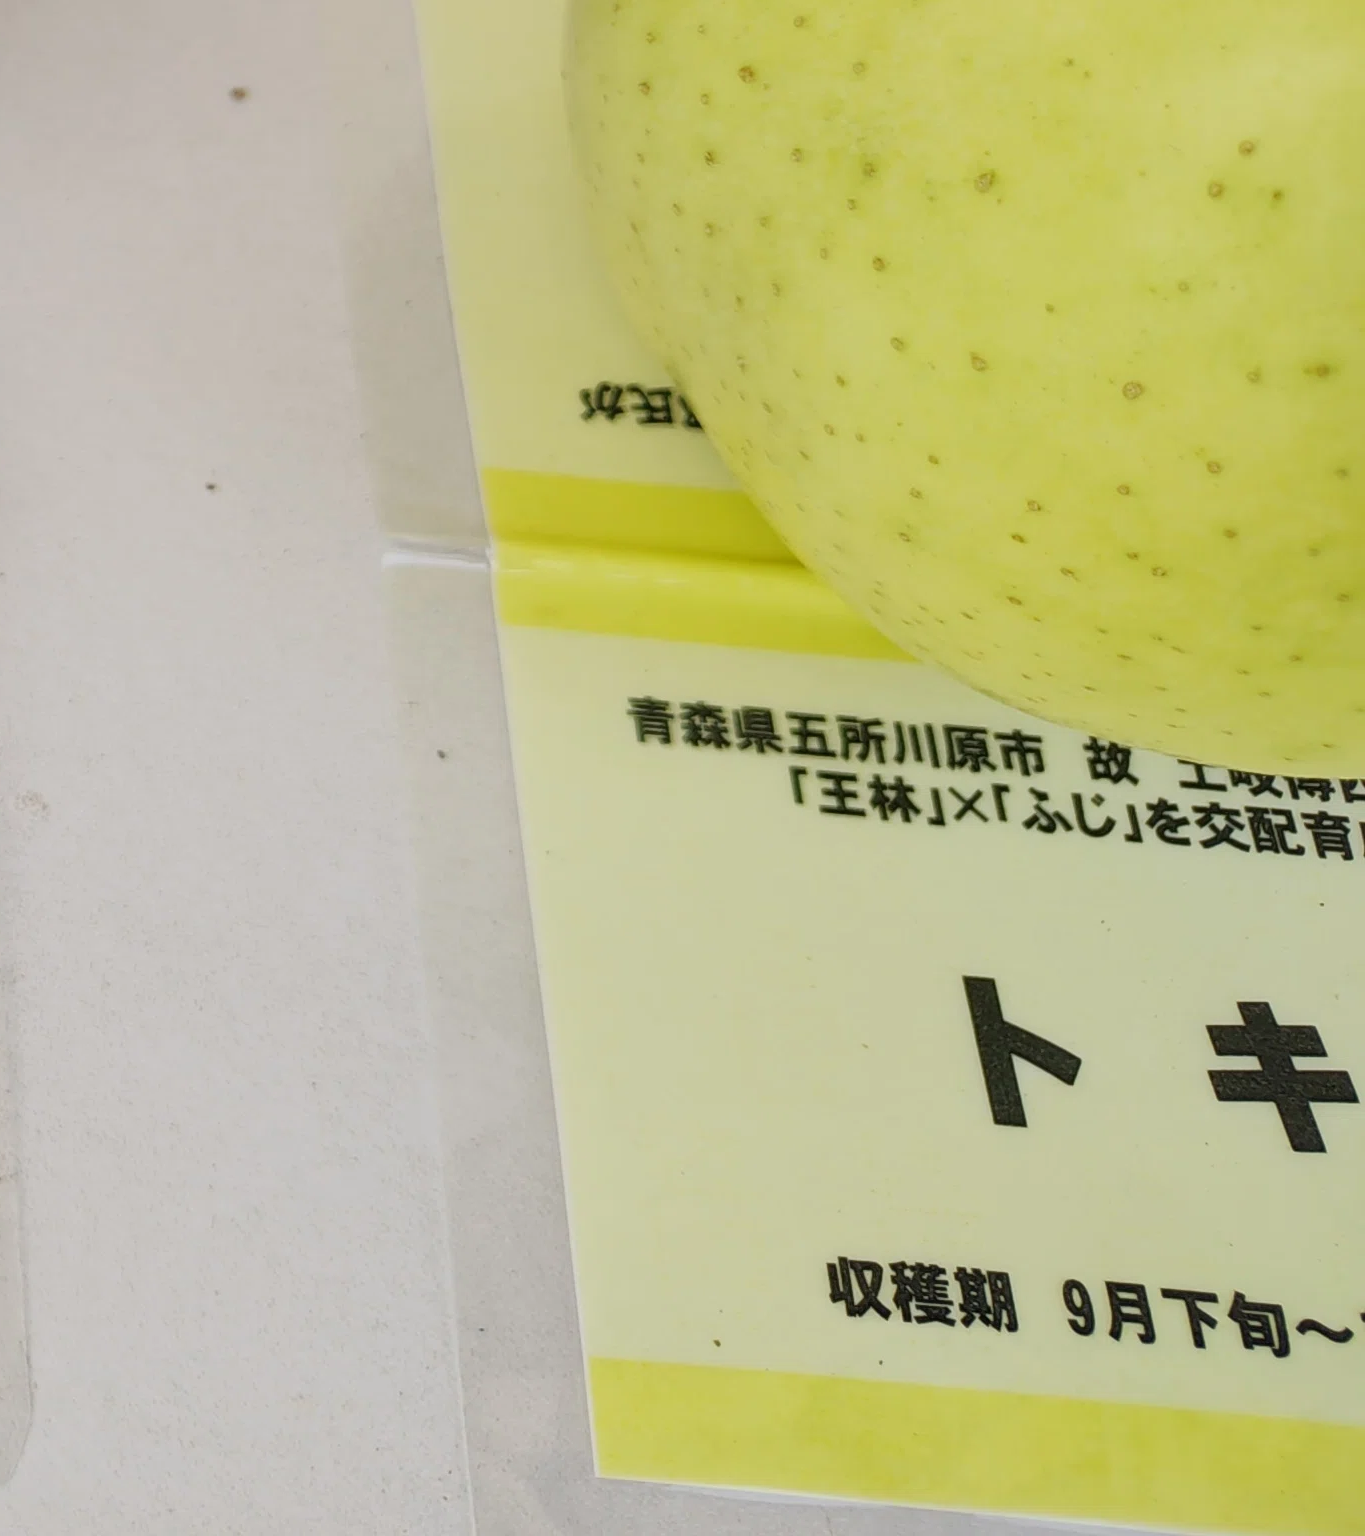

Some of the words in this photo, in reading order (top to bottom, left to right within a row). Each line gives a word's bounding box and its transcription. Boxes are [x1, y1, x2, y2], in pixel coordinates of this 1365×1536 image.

[627, 696, 1045, 777] 青森県五所川原市
[1082, 736, 1140, 786] 故
[787, 765, 1365, 862] 「王林」×「ふじ」を交配育
[825, 1255, 1021, 1333] 収穫期
